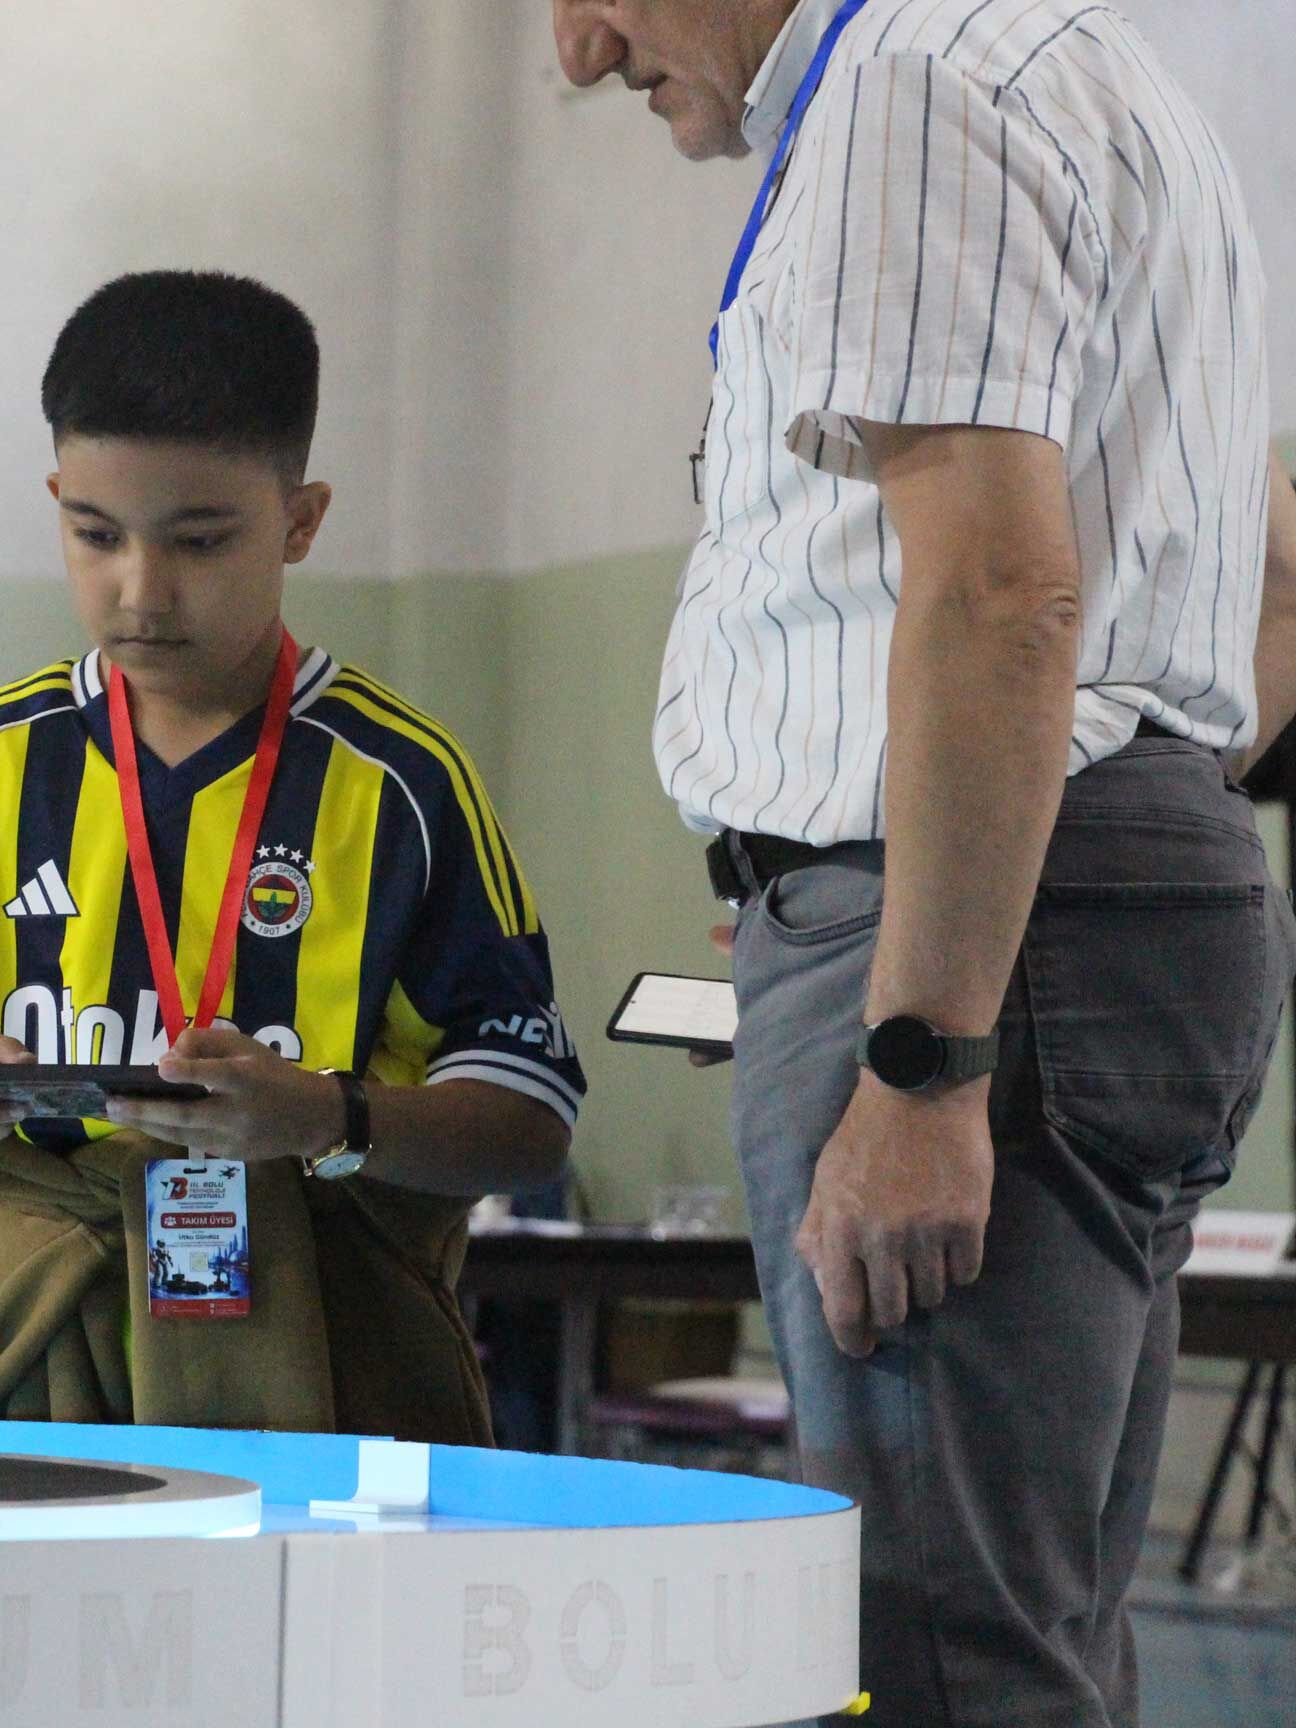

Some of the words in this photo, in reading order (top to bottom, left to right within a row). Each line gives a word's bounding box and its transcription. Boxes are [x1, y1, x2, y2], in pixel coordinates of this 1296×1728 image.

[276, 864, 302, 884] SPOR
[258, 925, 281, 936] 1907
[181, 1217, 208, 1225] TAKIM
[209, 1215, 234, 1225] ÜYESİ
[461, 1569, 756, 1698] BOLU
